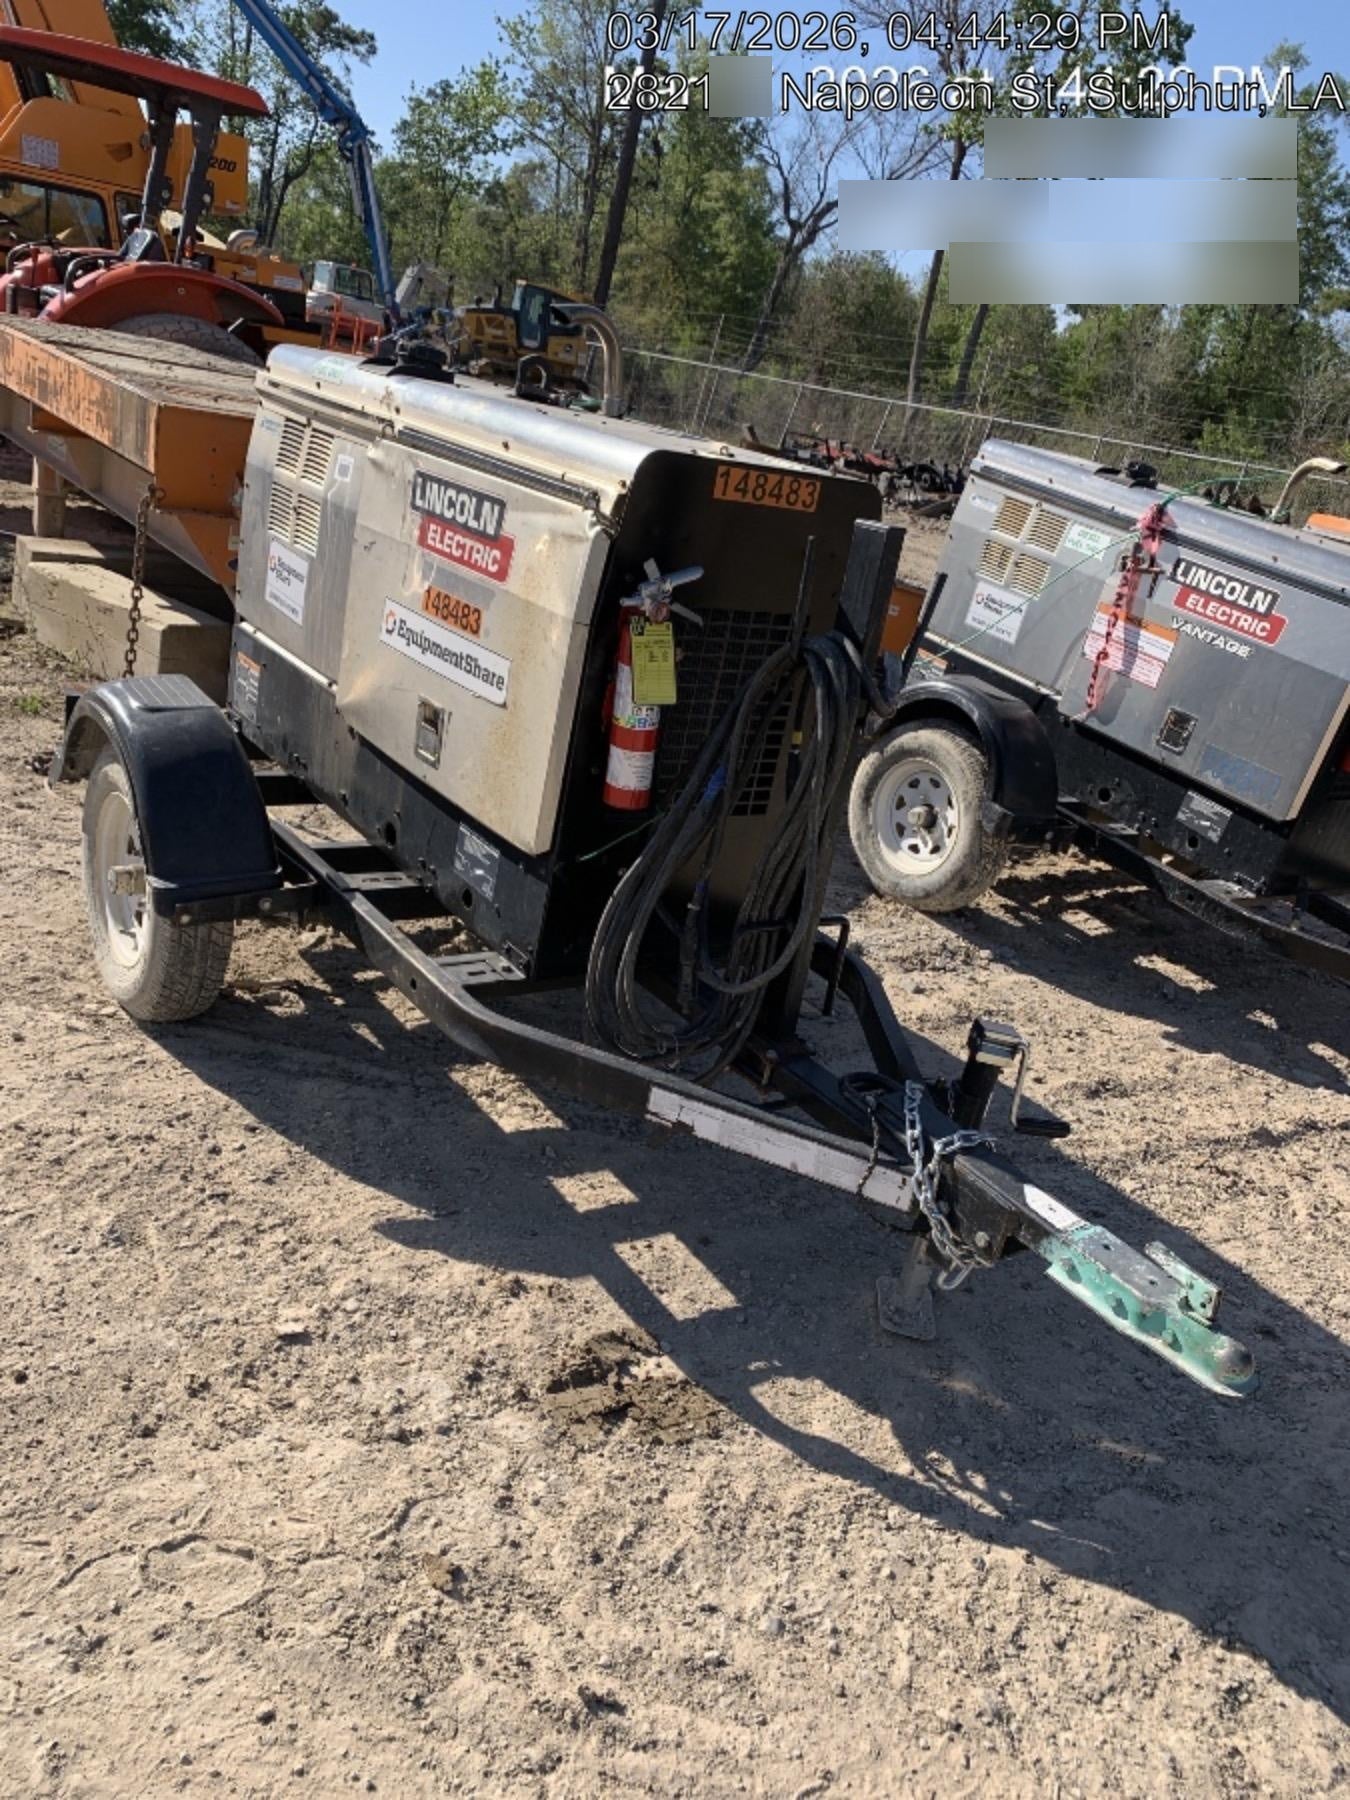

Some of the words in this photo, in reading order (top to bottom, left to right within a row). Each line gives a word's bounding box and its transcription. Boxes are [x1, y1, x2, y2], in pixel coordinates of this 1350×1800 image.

[415, 477, 501, 536] LINCOLN
[718, 467, 818, 509] 148483
[427, 523, 501, 574] ELECTRIC
[425, 584, 482, 635] 148483
[1176, 561, 1273, 614] LINCOLN
[1172, 616, 1252, 658] VANTAGE
[1185, 593, 1271, 637] ELECTRIC
[397, 617, 505, 691] EquipmentShare
